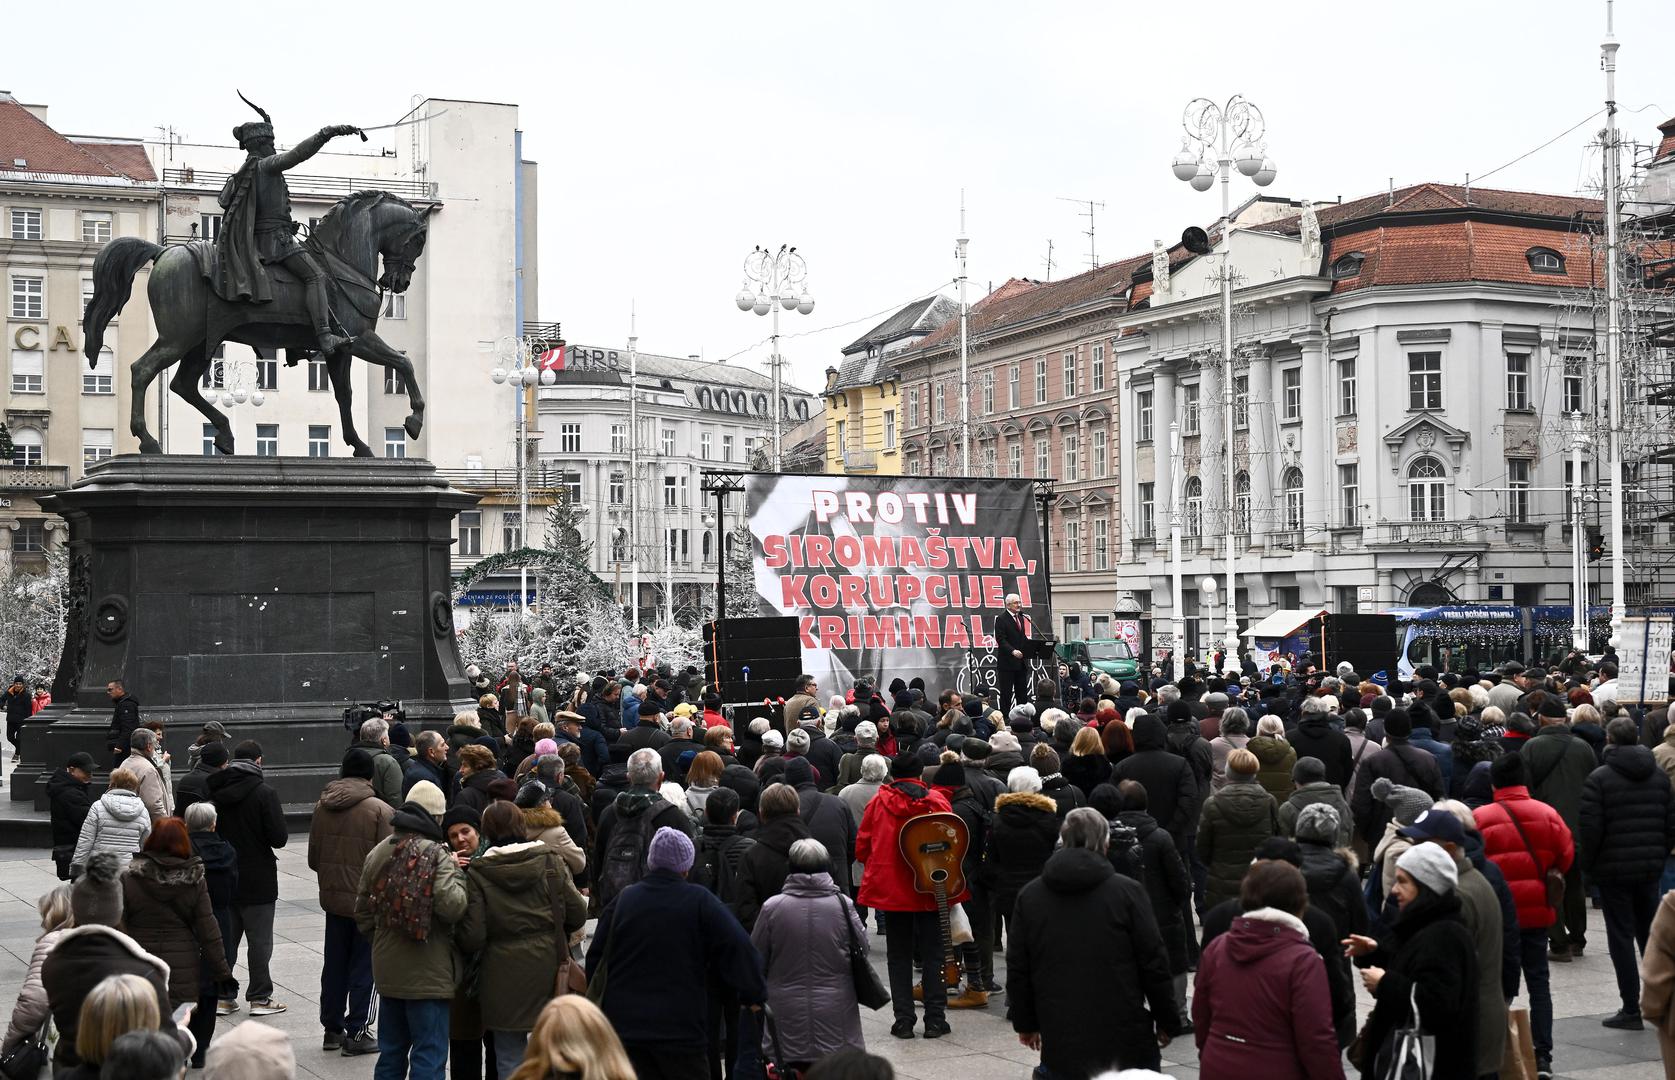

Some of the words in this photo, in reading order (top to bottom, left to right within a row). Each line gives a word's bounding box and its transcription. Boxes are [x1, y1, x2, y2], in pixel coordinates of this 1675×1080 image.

[812, 490, 977, 525] PROTIV
[763, 527, 1036, 575] SIROMAŠTVA,
[780, 574, 1005, 608] KORUPCIJE
[1016, 575, 1032, 608] I
